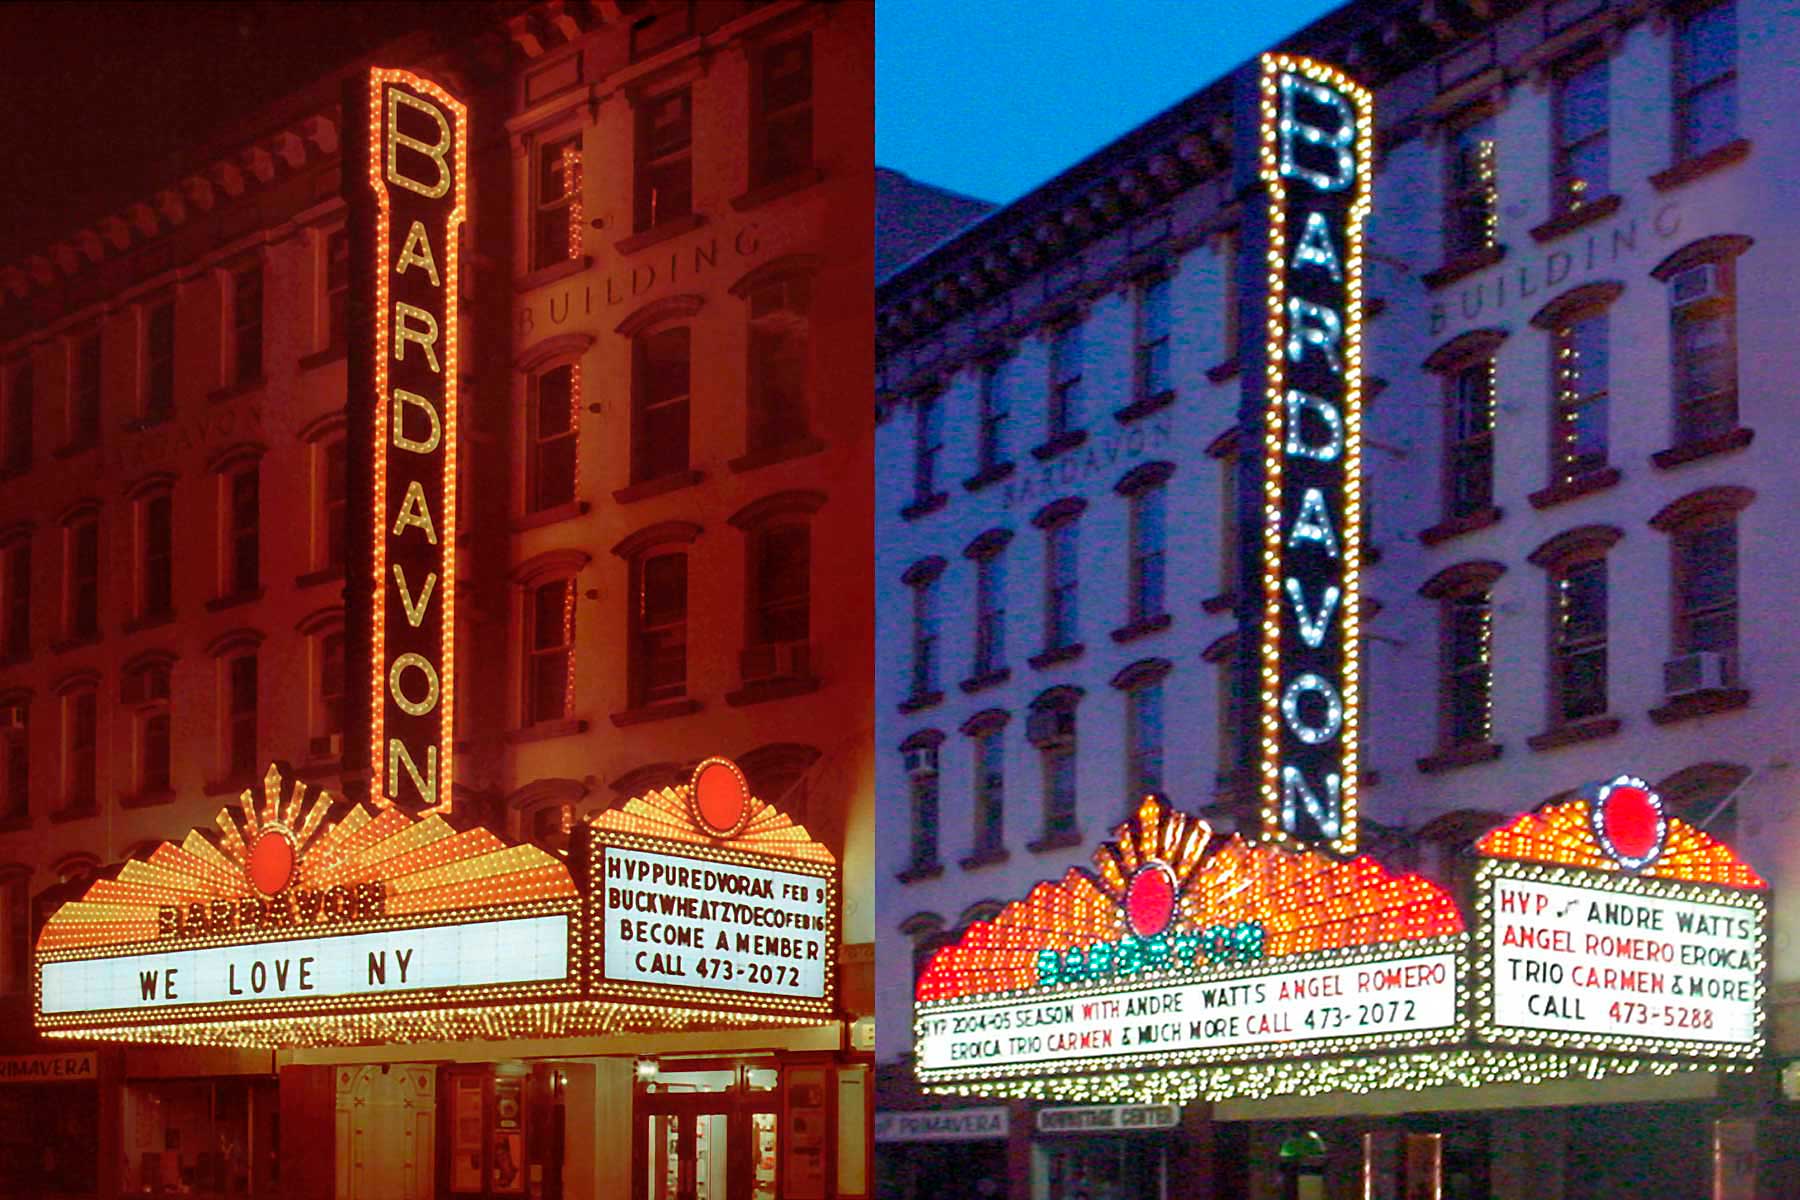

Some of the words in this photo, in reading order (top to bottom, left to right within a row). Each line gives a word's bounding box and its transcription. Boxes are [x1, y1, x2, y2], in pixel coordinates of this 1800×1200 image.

[518, 223, 760, 336] BUILDING
[1428, 204, 1681, 336] BUILDING
[388, 87, 451, 804] BARDAVON
[1280, 72, 1355, 838] BARDAVON
[158, 880, 386, 939] BARDAVON
[783, 884, 808, 902] FEB
[816, 888, 824, 904] 9
[1501, 889, 1548, 916] HVP
[1587, 901, 1664, 931] ANDRE
[1677, 910, 1750, 940] WATTS
[620, 918, 704, 949] BECOME
[715, 930, 730, 951] A
[736, 932, 819, 961] MEMBER
[1502, 925, 1576, 953] ANGEL
[1586, 933, 1674, 962] ROMERO
[139, 968, 178, 1001] WE
[229, 956, 315, 996] LOVE
[368, 948, 413, 986] NY
[635, 950, 685, 977] CALL
[696, 957, 799, 987] 473-2072
[1508, 958, 1563, 985] TRIO
[1572, 965, 1664, 994] CARMEN
[1689, 975, 1750, 1002] MORE
[952, 1011, 1010, 1034] 2004-05
[1016, 1003, 1074, 1028] SEASON
[1081, 1000, 1120, 1021] WITH
[1125, 992, 1183, 1017] ANDRE
[1202, 983, 1266, 1009] WATTS
[1278, 975, 1344, 1001] ANGEL
[1358, 963, 1446, 993] ROMERO
[1527, 994, 1586, 1021] CALL
[1608, 1001, 1714, 1029] 473-5288
[1009, 1034, 1042, 1056] TRIO
[1047, 1028, 1112, 1052] CARMEN
[1138, 1021, 1181, 1044] MUCH
[1189, 1016, 1238, 1042] MORE
[1246, 1011, 1293, 1035] CALL
[1304, 1000, 1416, 1031] 473-2072
